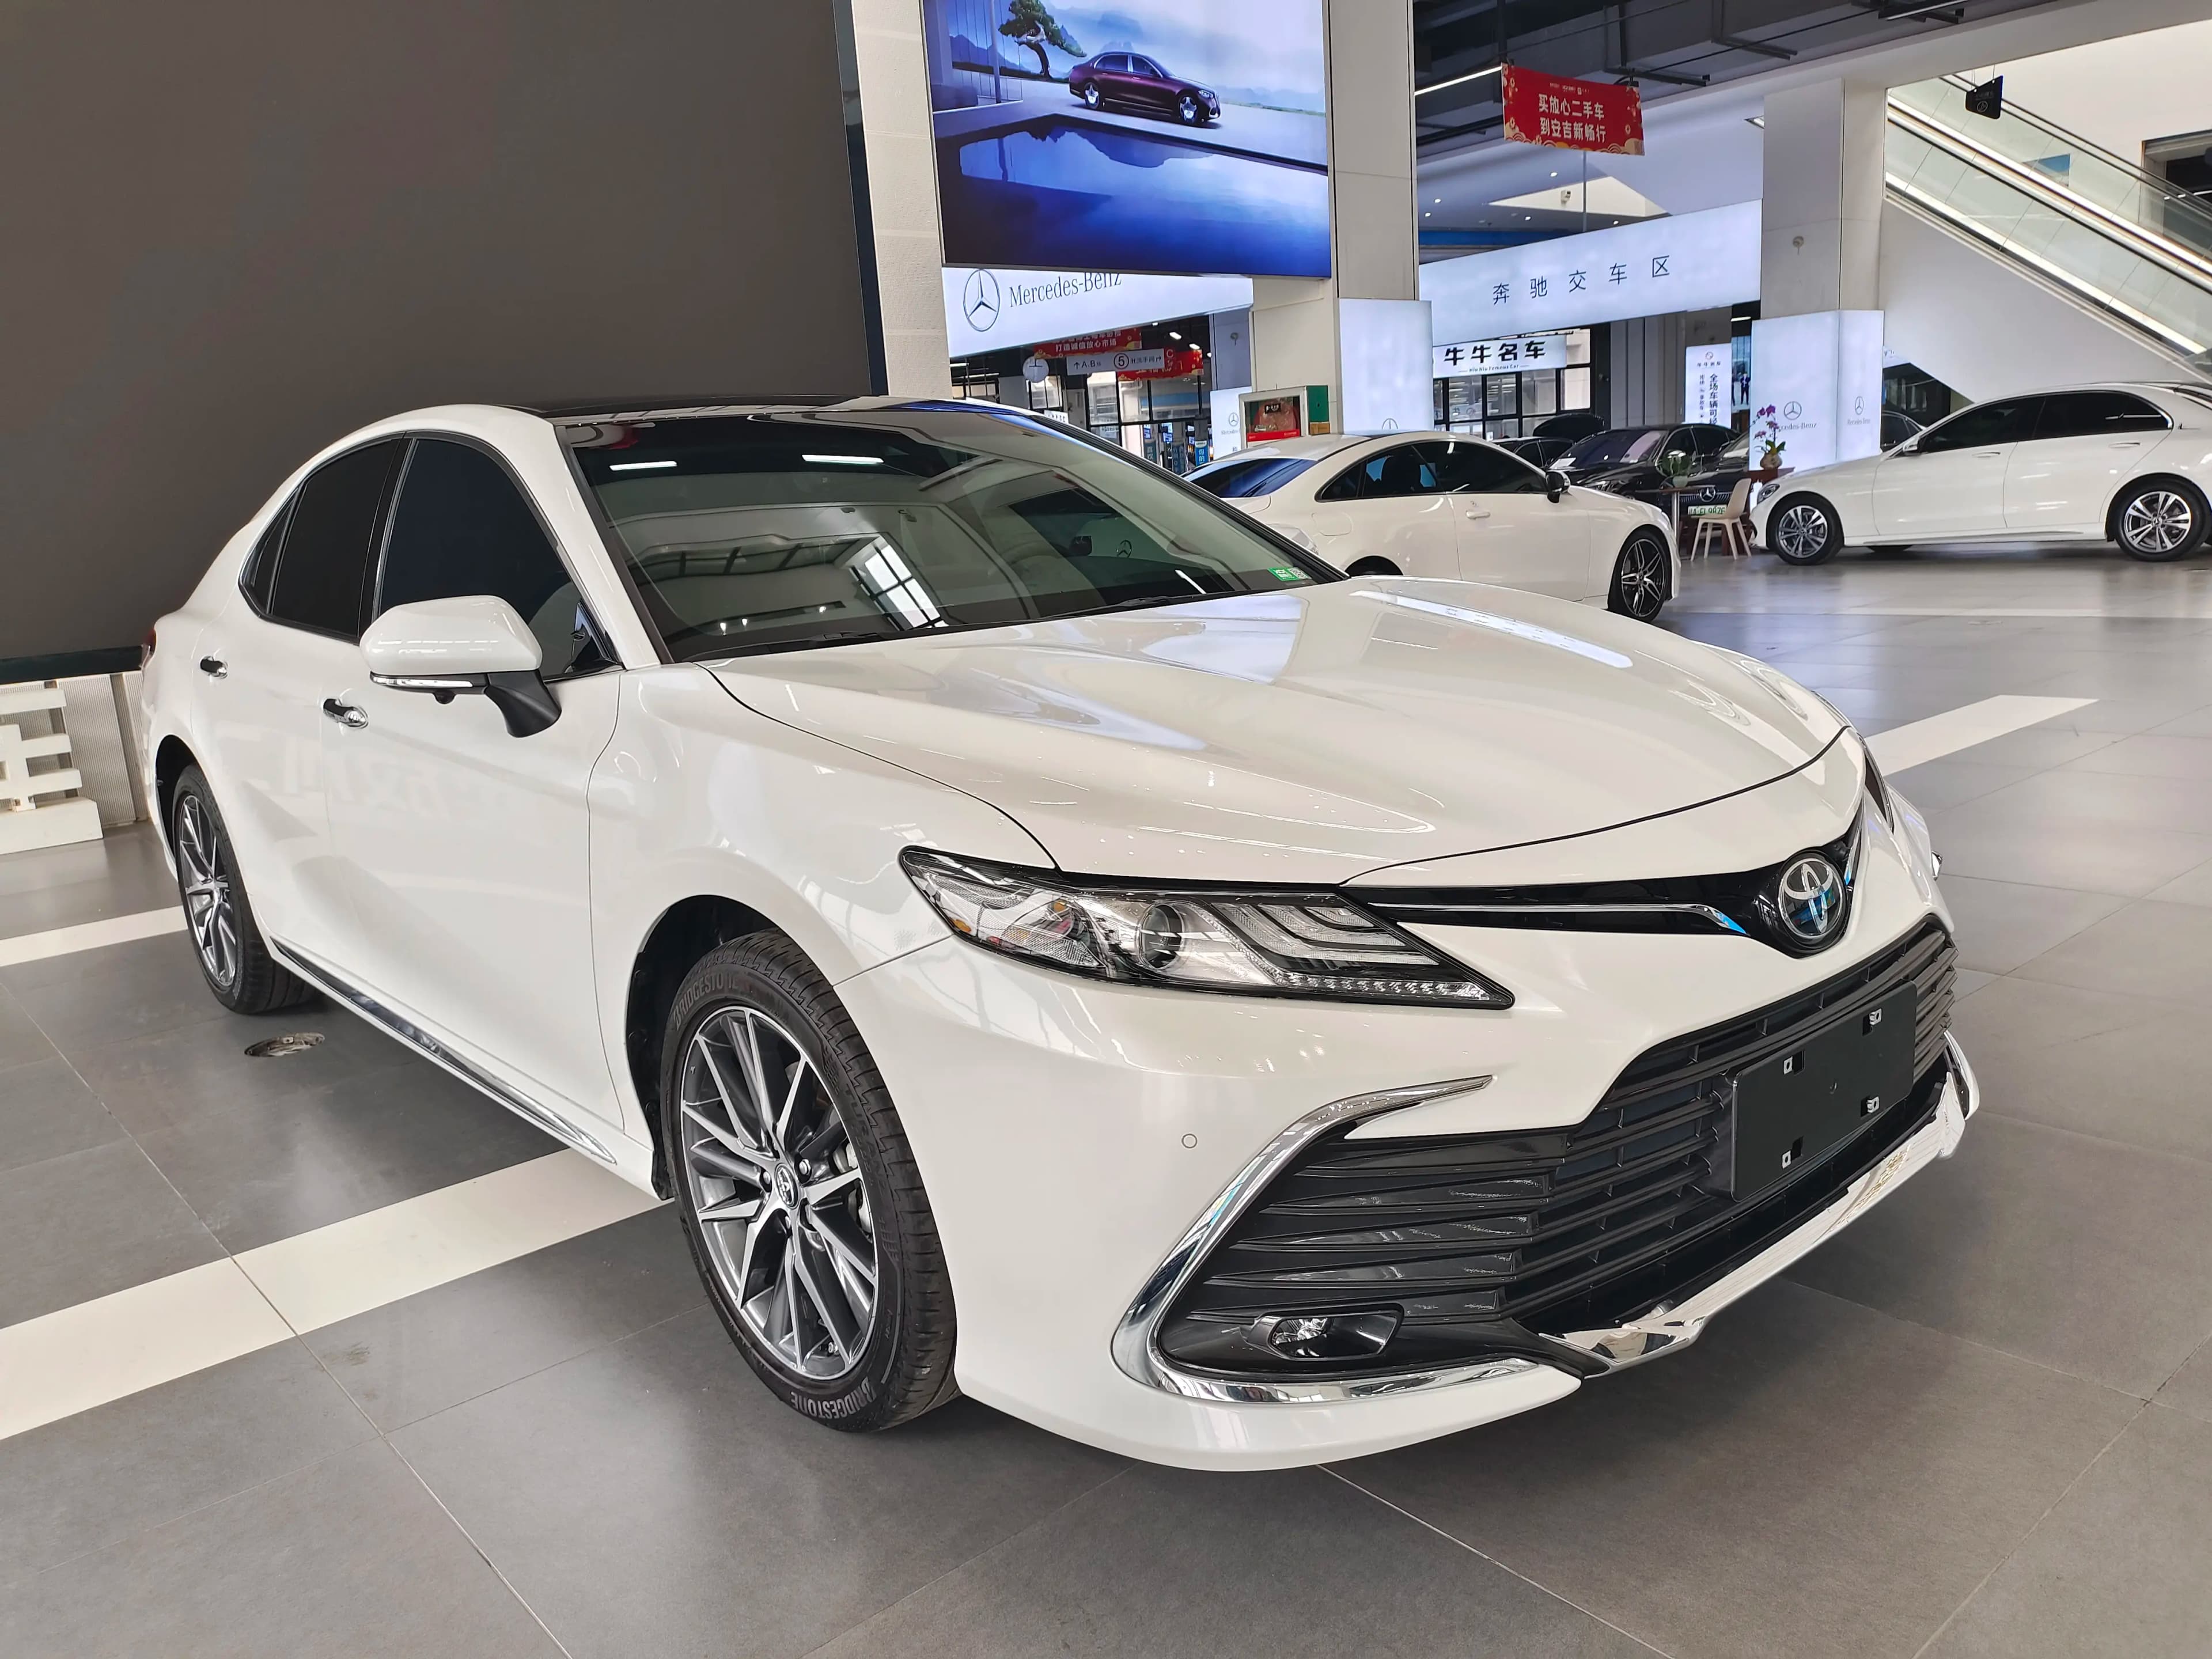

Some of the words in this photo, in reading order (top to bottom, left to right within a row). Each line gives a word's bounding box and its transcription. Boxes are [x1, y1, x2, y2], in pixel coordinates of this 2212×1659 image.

[1538, 93, 1605, 120] 买放心二手车
[1539, 117, 1606, 143] 到安吉新畅行
[1009, 272, 1122, 308] Mercedes-Benz
[1493, 255, 1670, 305] 奔驰交车区
[1444, 340, 1546, 366] 牛牛名车
[790, 1376, 877, 1420] BRIDGESTONE
